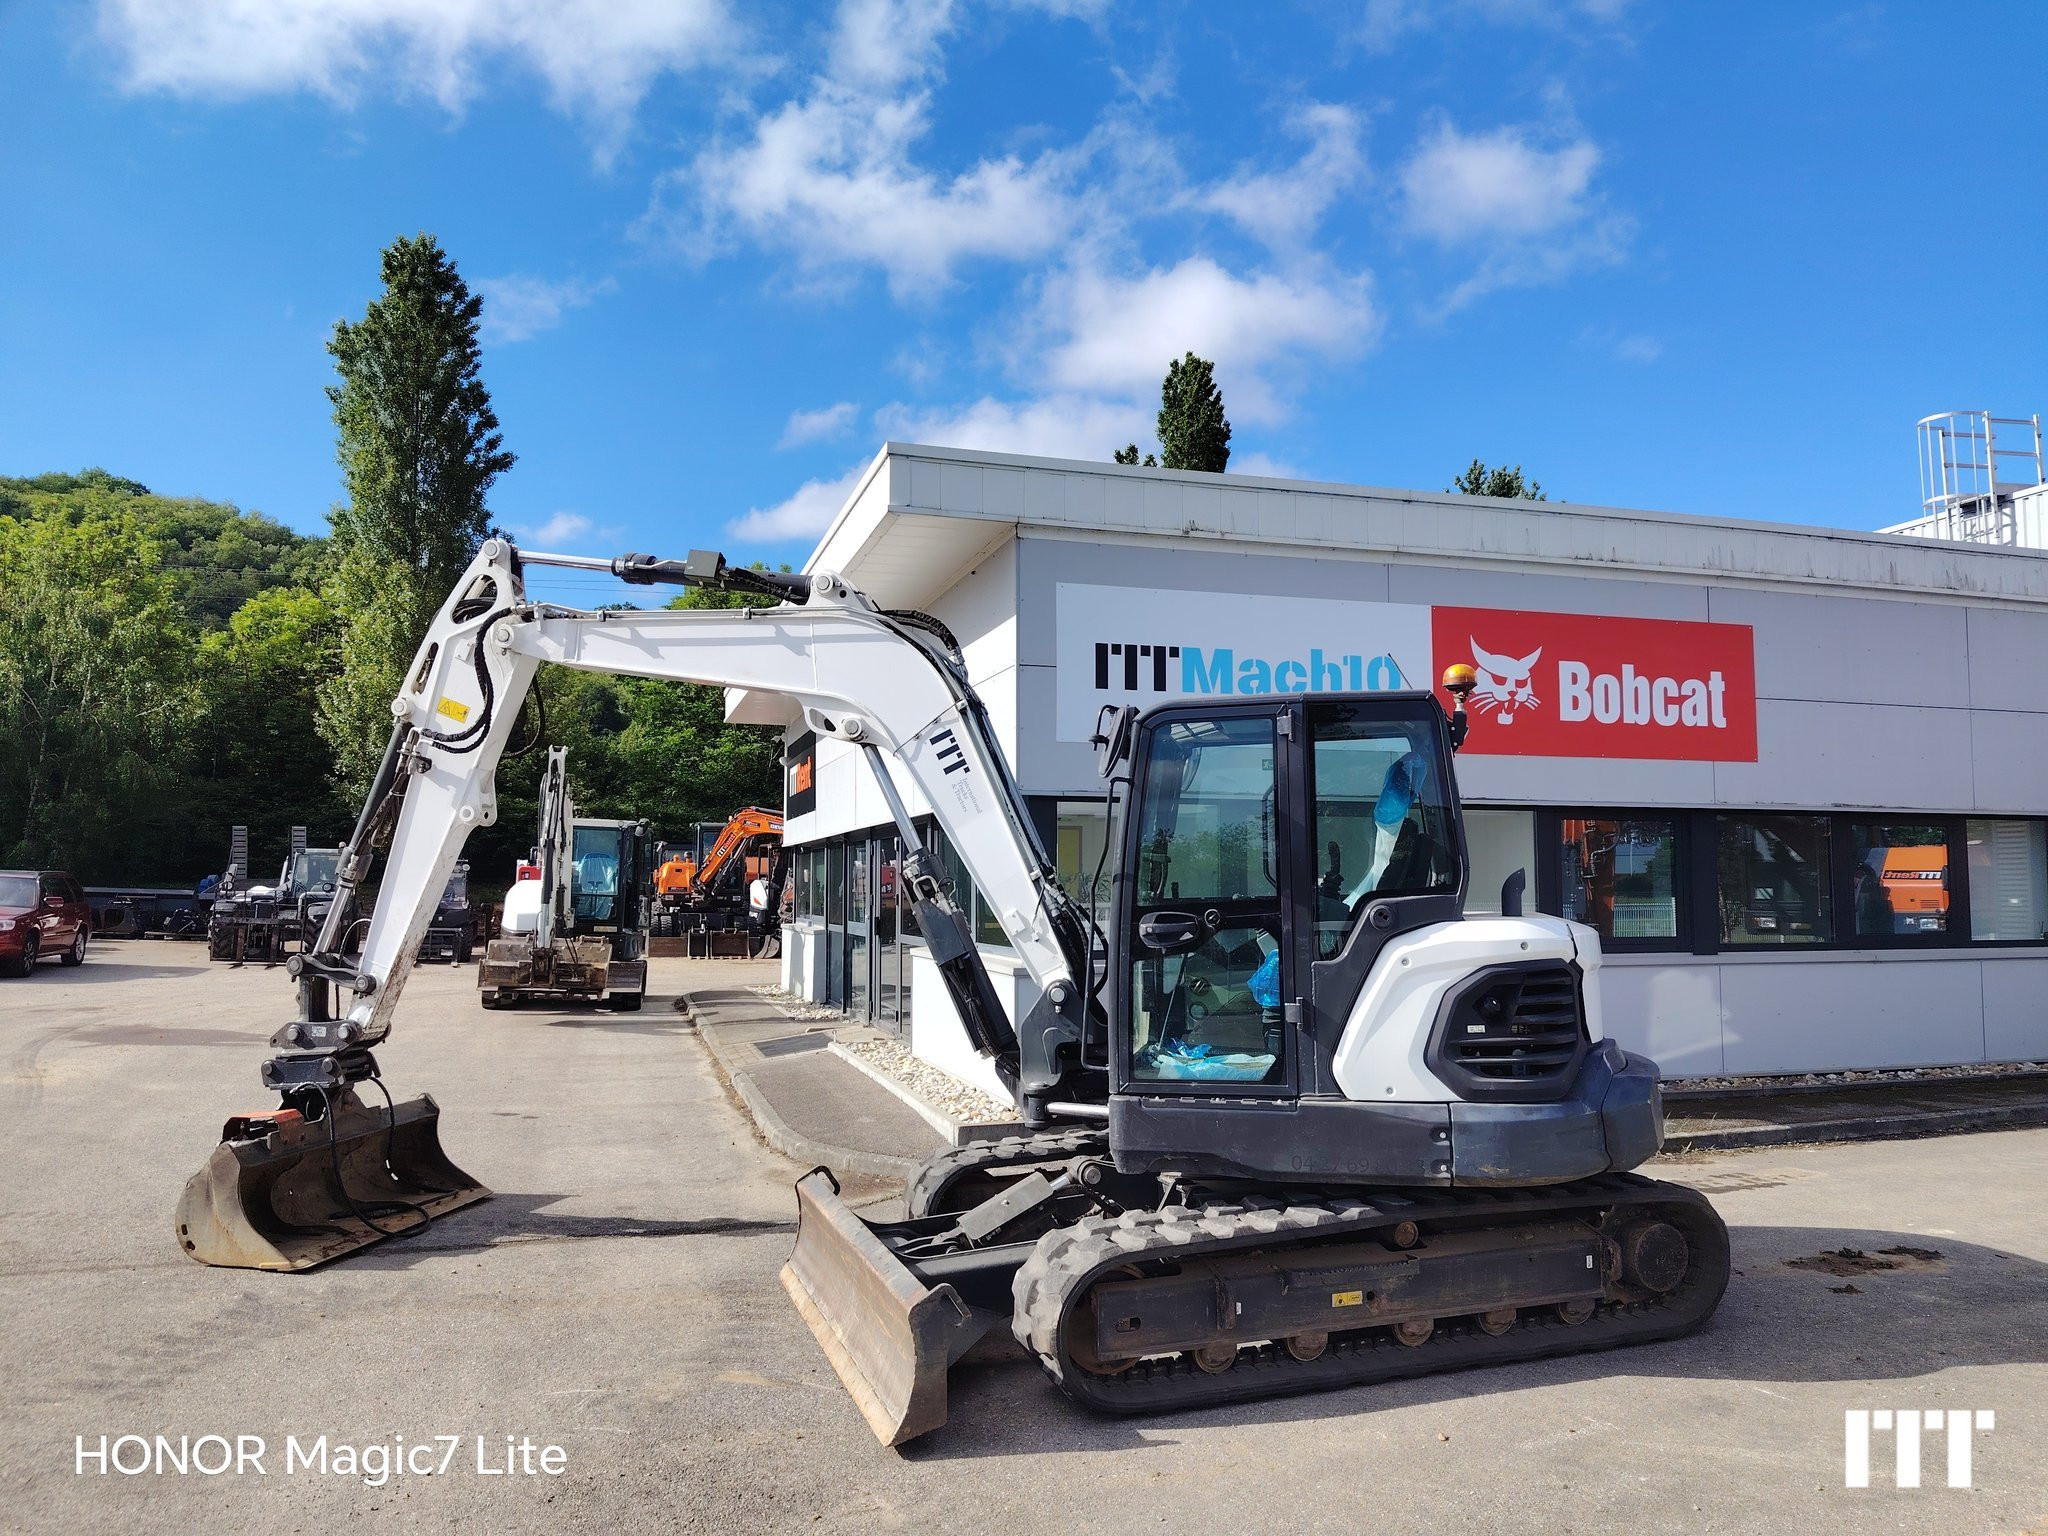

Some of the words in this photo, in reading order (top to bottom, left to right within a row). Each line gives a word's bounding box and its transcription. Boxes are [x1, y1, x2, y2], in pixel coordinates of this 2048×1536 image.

[1558, 661, 1727, 728] Bobcat
[963, 777, 984, 814] International
[1291, 1155, 1314, 1171] 04
[1347, 1158, 1370, 1173] 69
